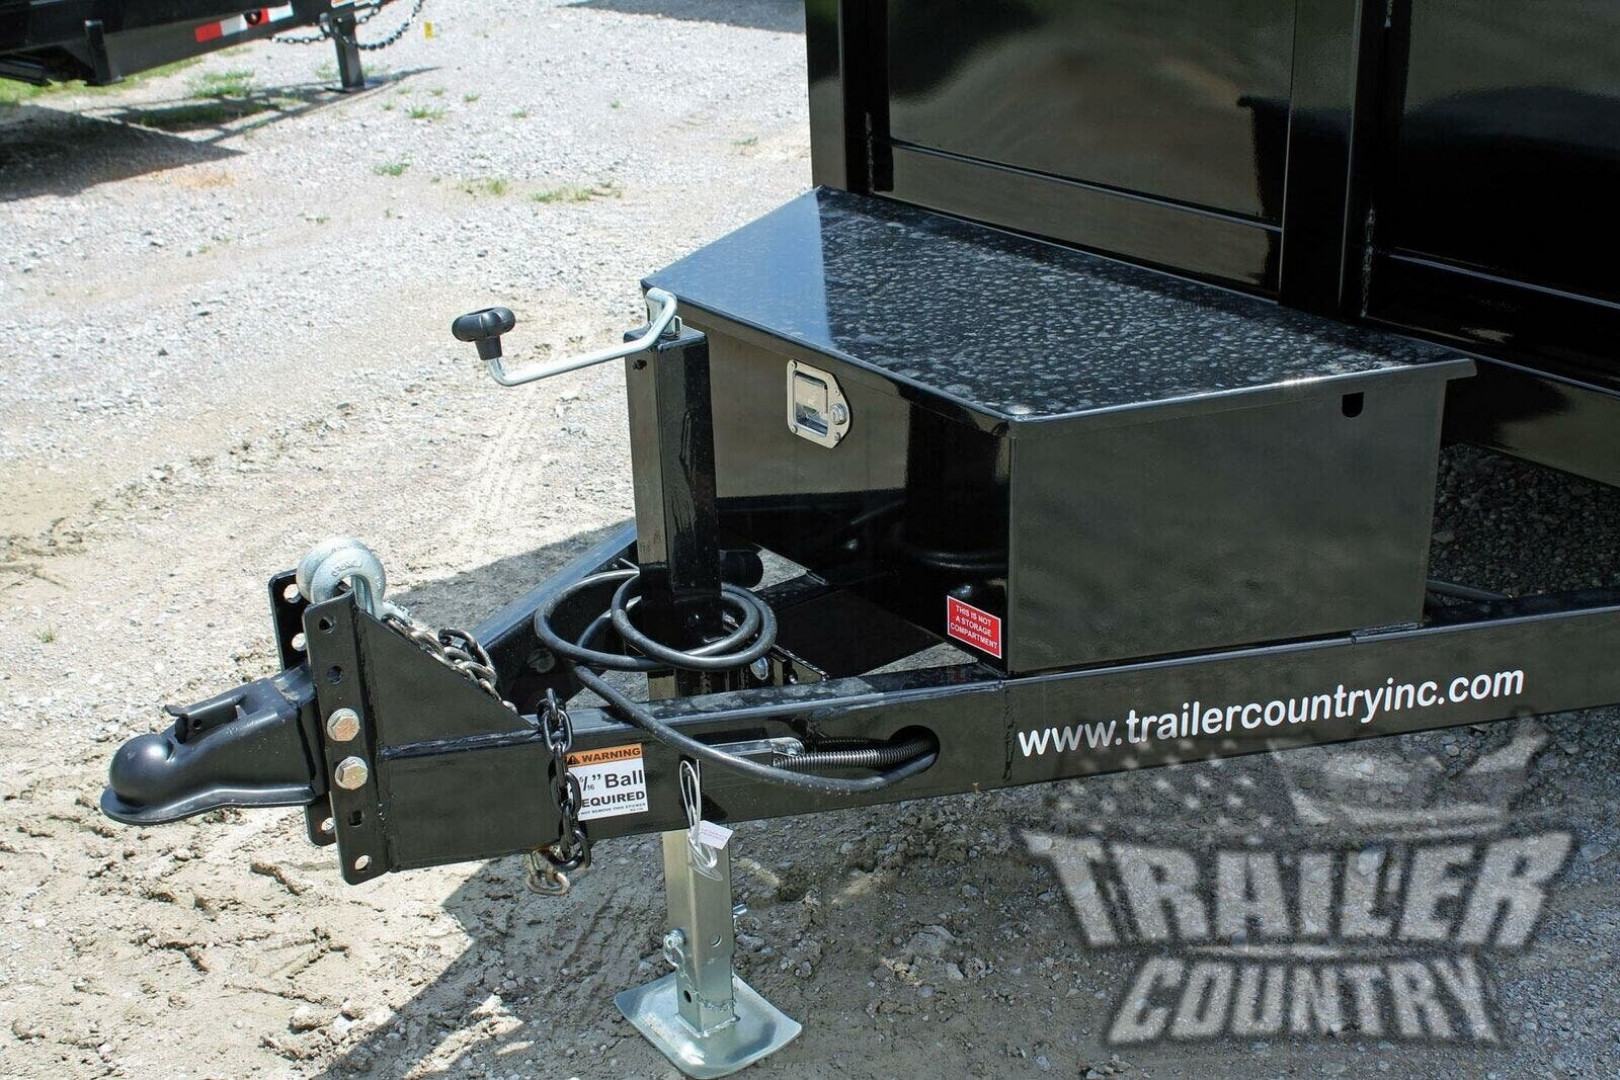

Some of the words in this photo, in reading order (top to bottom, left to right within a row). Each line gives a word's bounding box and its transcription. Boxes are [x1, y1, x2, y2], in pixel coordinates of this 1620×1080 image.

[955, 605, 969, 616] THIS
[970, 612, 977, 620] IS
[978, 615, 991, 626] NOT
[950, 622, 998, 649] COMPARTMENT
[961, 617, 992, 637] STORAGE
[1018, 669, 1525, 757] www.trailercountryinc.com
[582, 747, 641, 762] WARNING
[604, 769, 643, 788] Ball
[581, 790, 645, 808] EQUIRED
